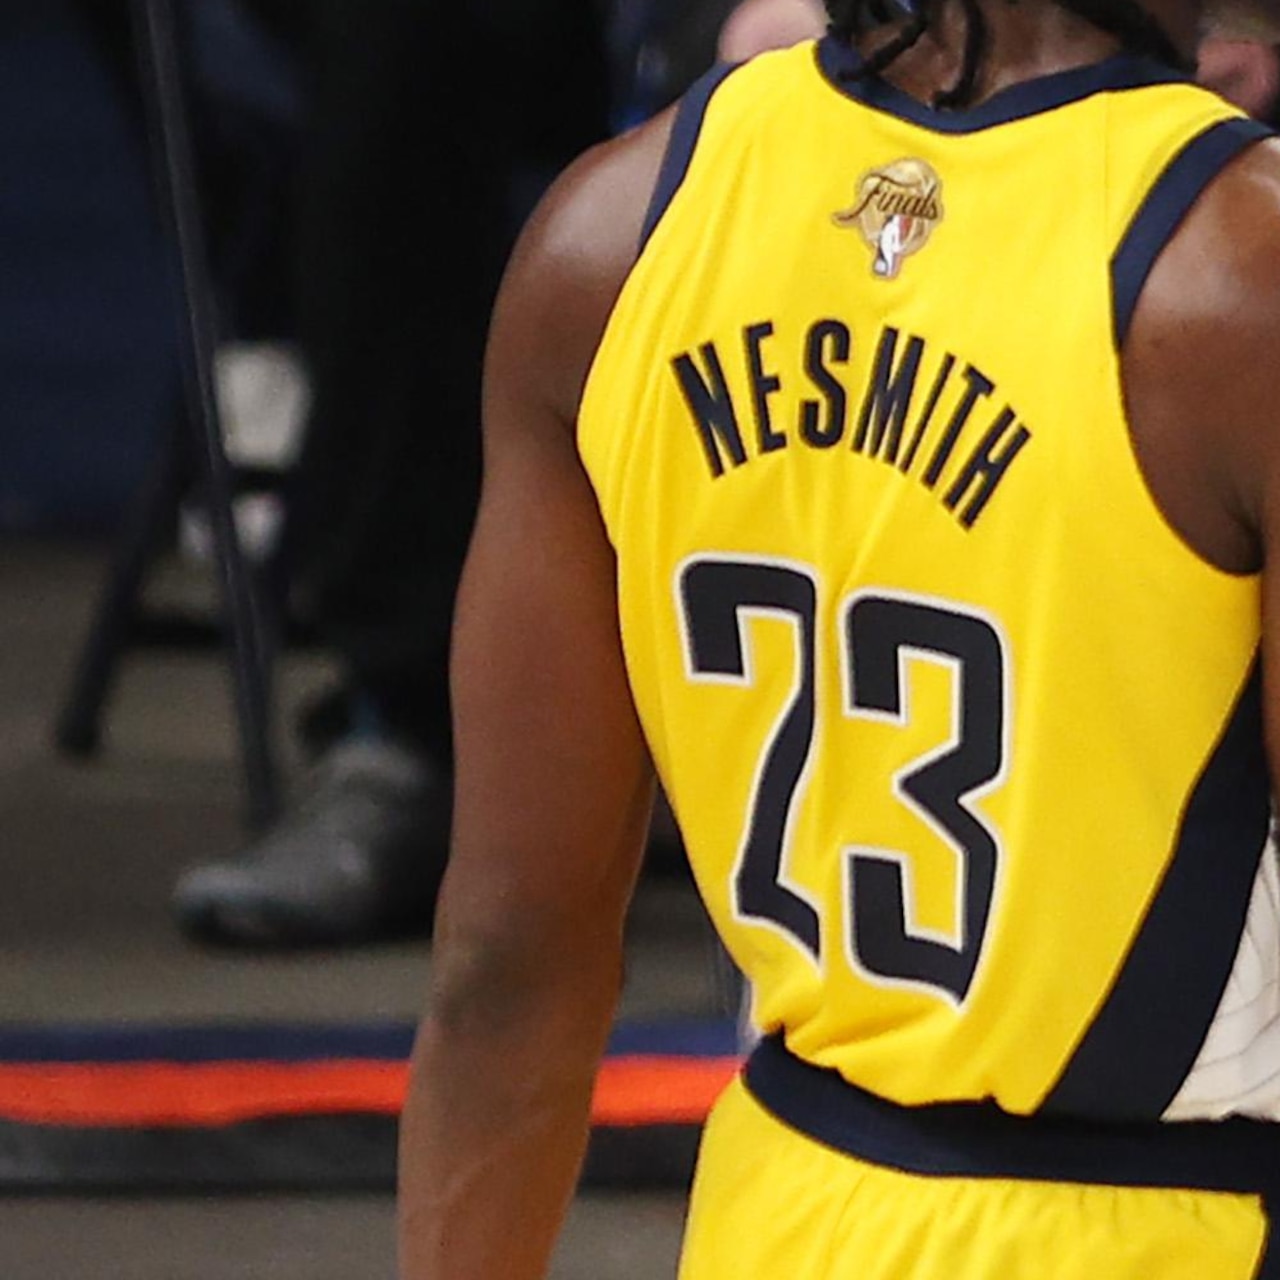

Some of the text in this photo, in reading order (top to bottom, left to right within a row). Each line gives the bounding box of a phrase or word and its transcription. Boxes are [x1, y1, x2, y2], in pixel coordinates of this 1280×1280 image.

[836, 171, 940, 221] Finals
[669, 318, 1034, 532] NESMITH
[673, 550, 1010, 1006] 23
